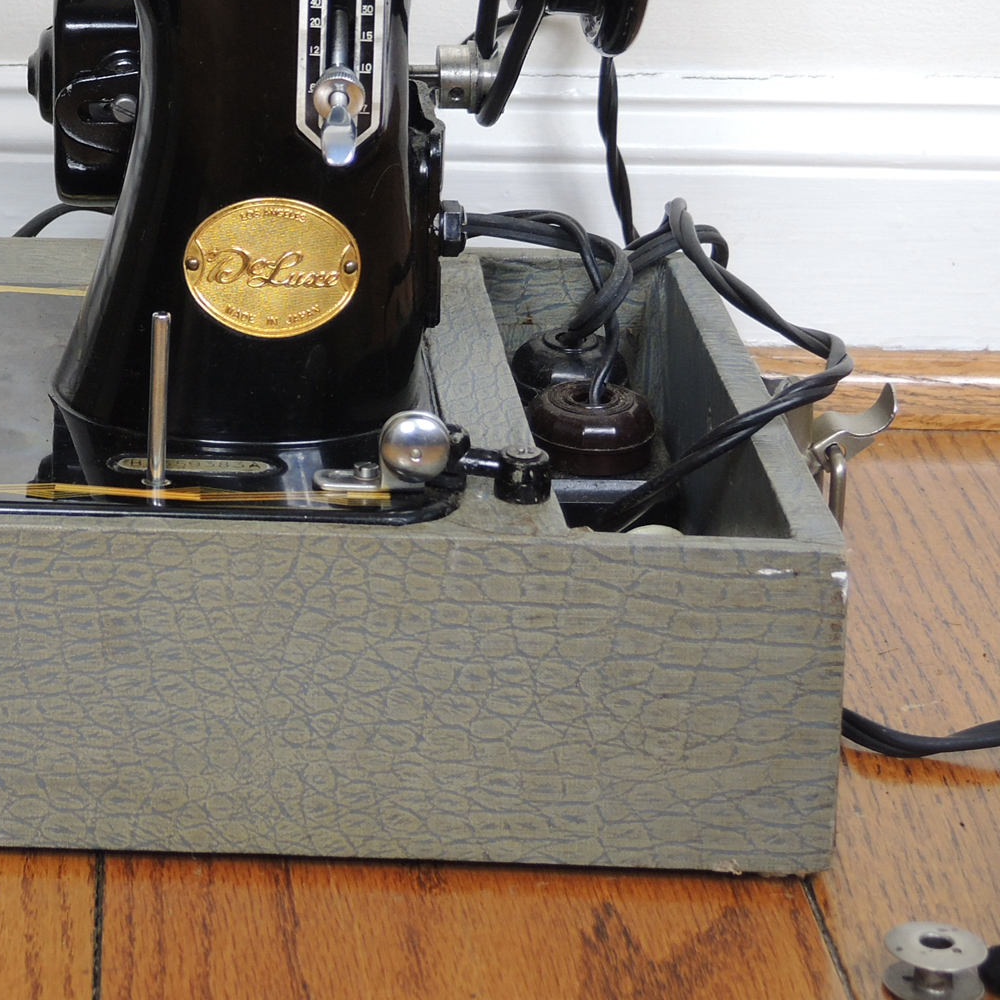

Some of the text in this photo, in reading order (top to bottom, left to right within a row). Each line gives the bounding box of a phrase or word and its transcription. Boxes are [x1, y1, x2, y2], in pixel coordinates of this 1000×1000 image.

[362, 4, 374, 14] 30
[309, 17, 321, 27] 20
[362, 31, 373, 40] 15
[309, 45, 320, 54] 12
[361, 63, 372, 72] 10
[224, 303, 321, 326] MADE IN JAPAN
